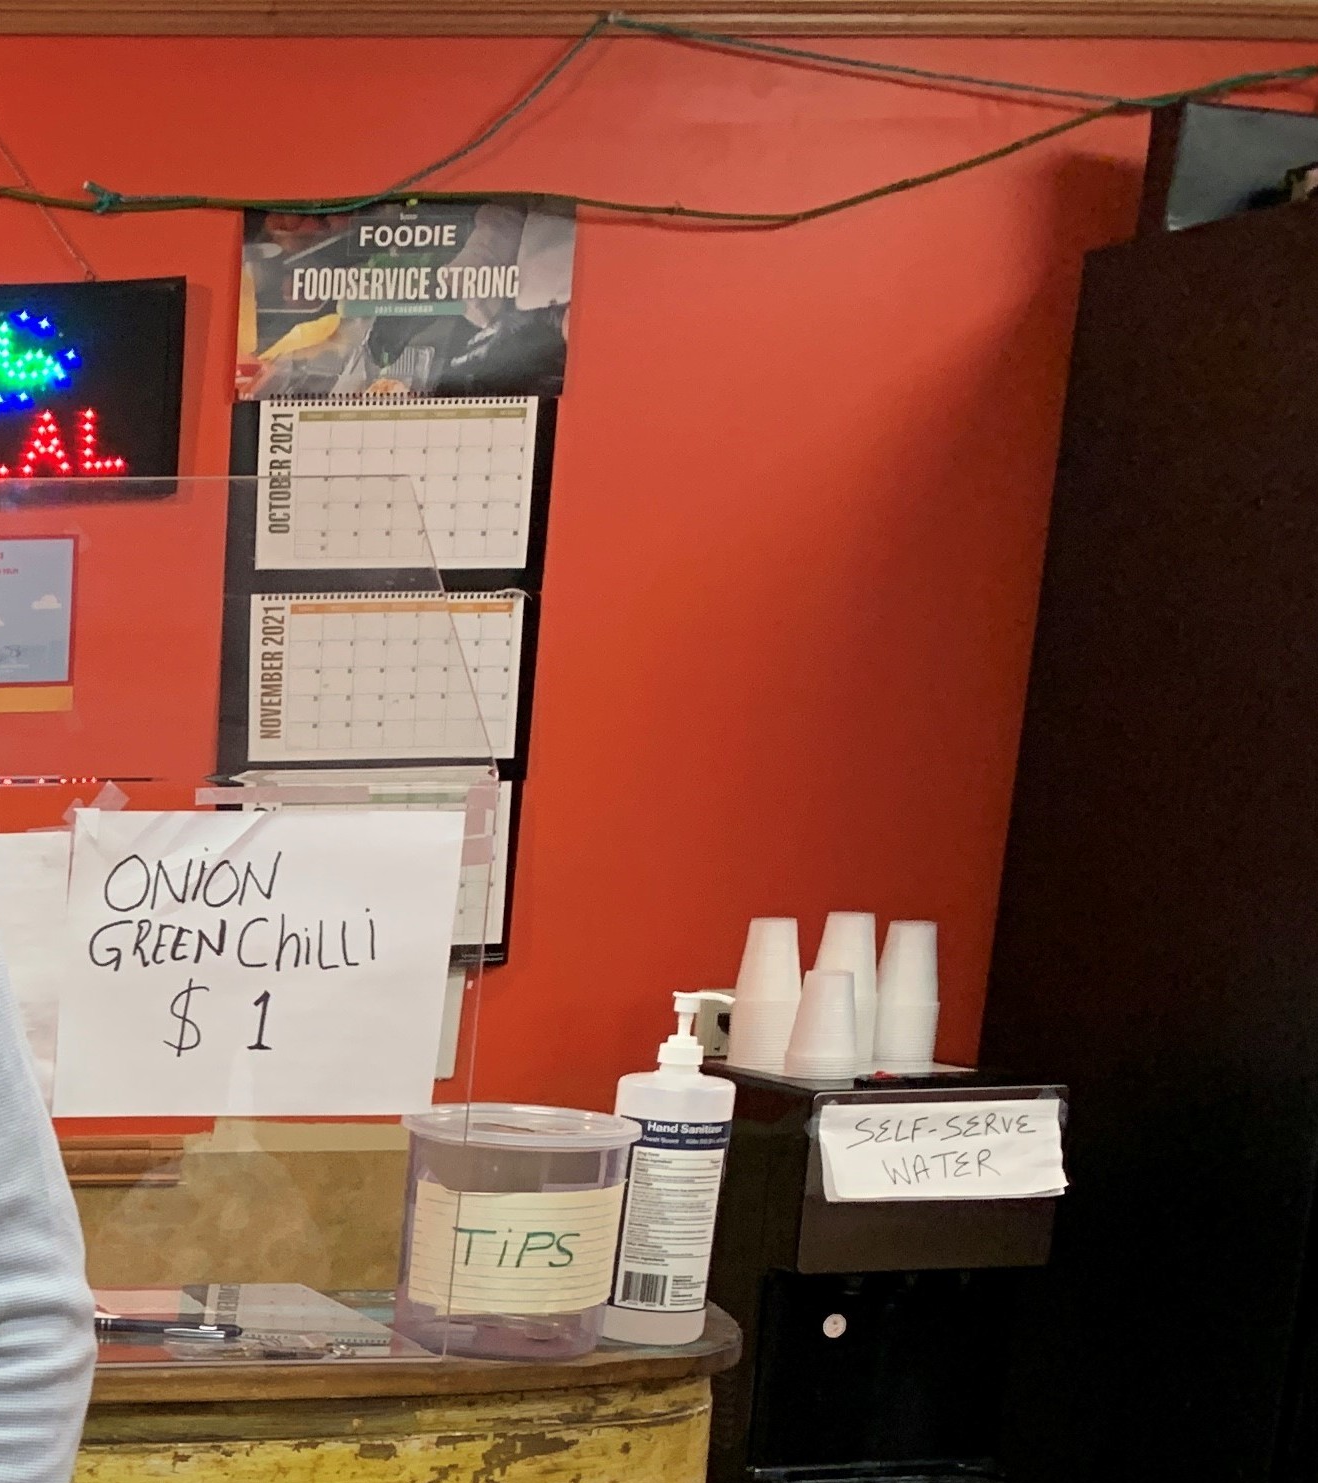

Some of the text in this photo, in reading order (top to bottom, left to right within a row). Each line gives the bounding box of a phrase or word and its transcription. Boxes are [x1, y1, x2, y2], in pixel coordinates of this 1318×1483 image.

[359, 225, 457, 247] FOODIE
[291, 264, 521, 301] FOODSERVICE STRONG
[268, 412, 295, 534] OCTOBER 2021
[259, 605, 286, 740] NOVEMBER 2021
[88, 919, 226, 971] GREEN
[163, 978, 274, 1058] $ 1
[647, 1121, 679, 1134] Hand
[846, 1112, 1037, 1150] SELF-SERVE
[881, 1148, 1002, 1187] WATER
